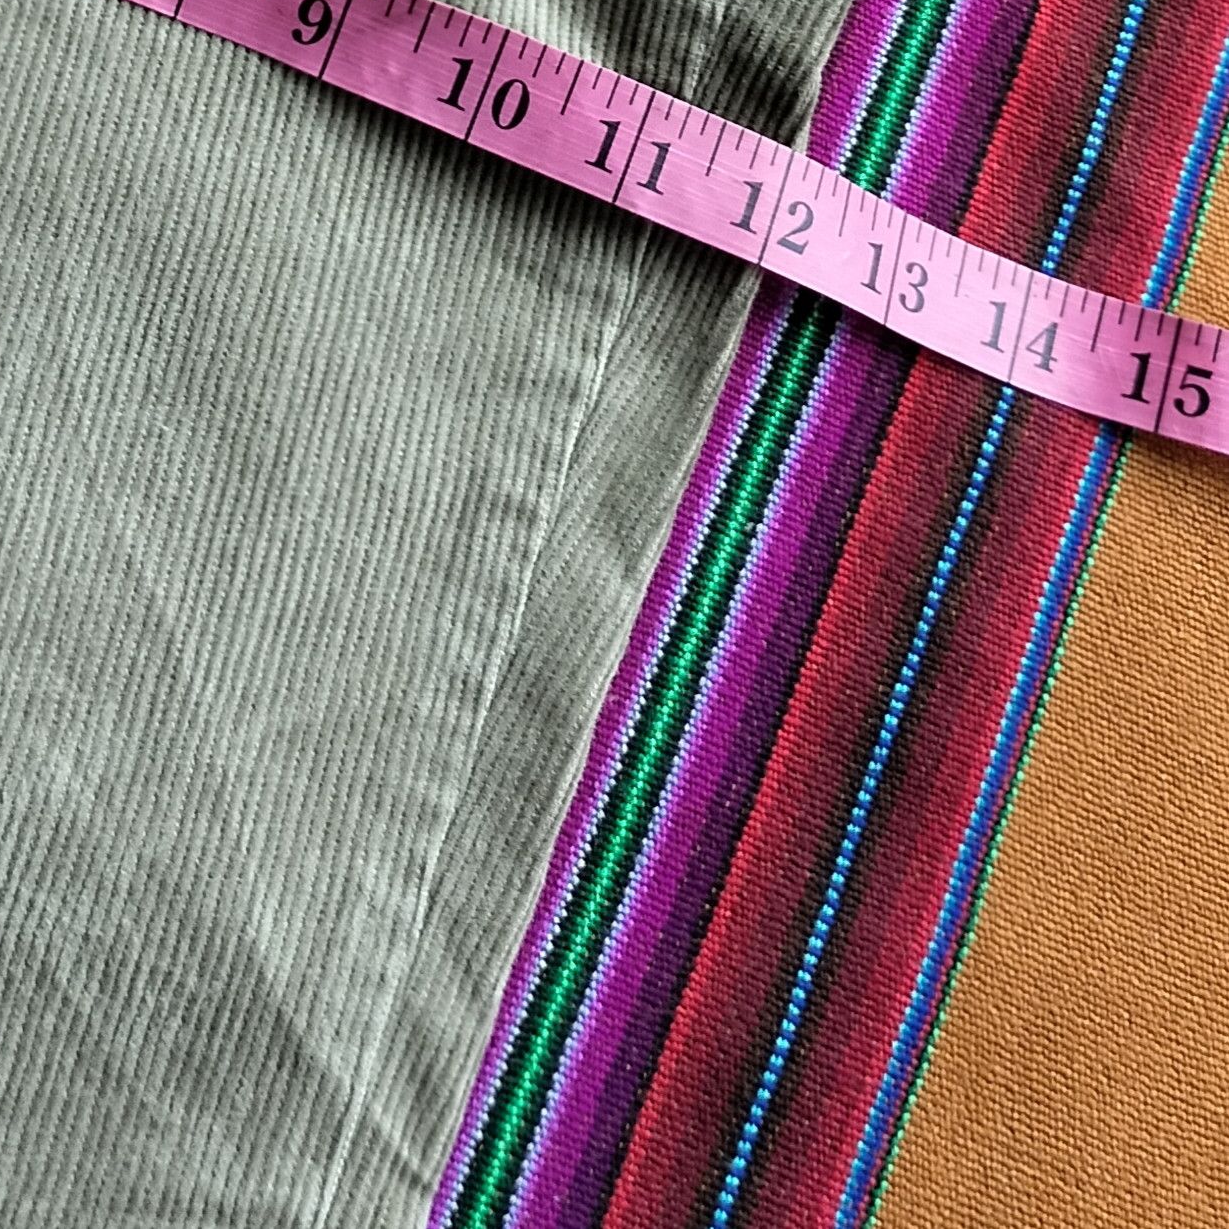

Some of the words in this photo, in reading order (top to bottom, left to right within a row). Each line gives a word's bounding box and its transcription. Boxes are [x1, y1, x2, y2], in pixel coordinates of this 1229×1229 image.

[438, 57, 532, 130] 10
[585, 120, 671, 196] 11
[730, 182, 814, 255] 12
[861, 243, 928, 314] 13
[979, 302, 1059, 373] 14
[1120, 353, 1212, 417] 15
